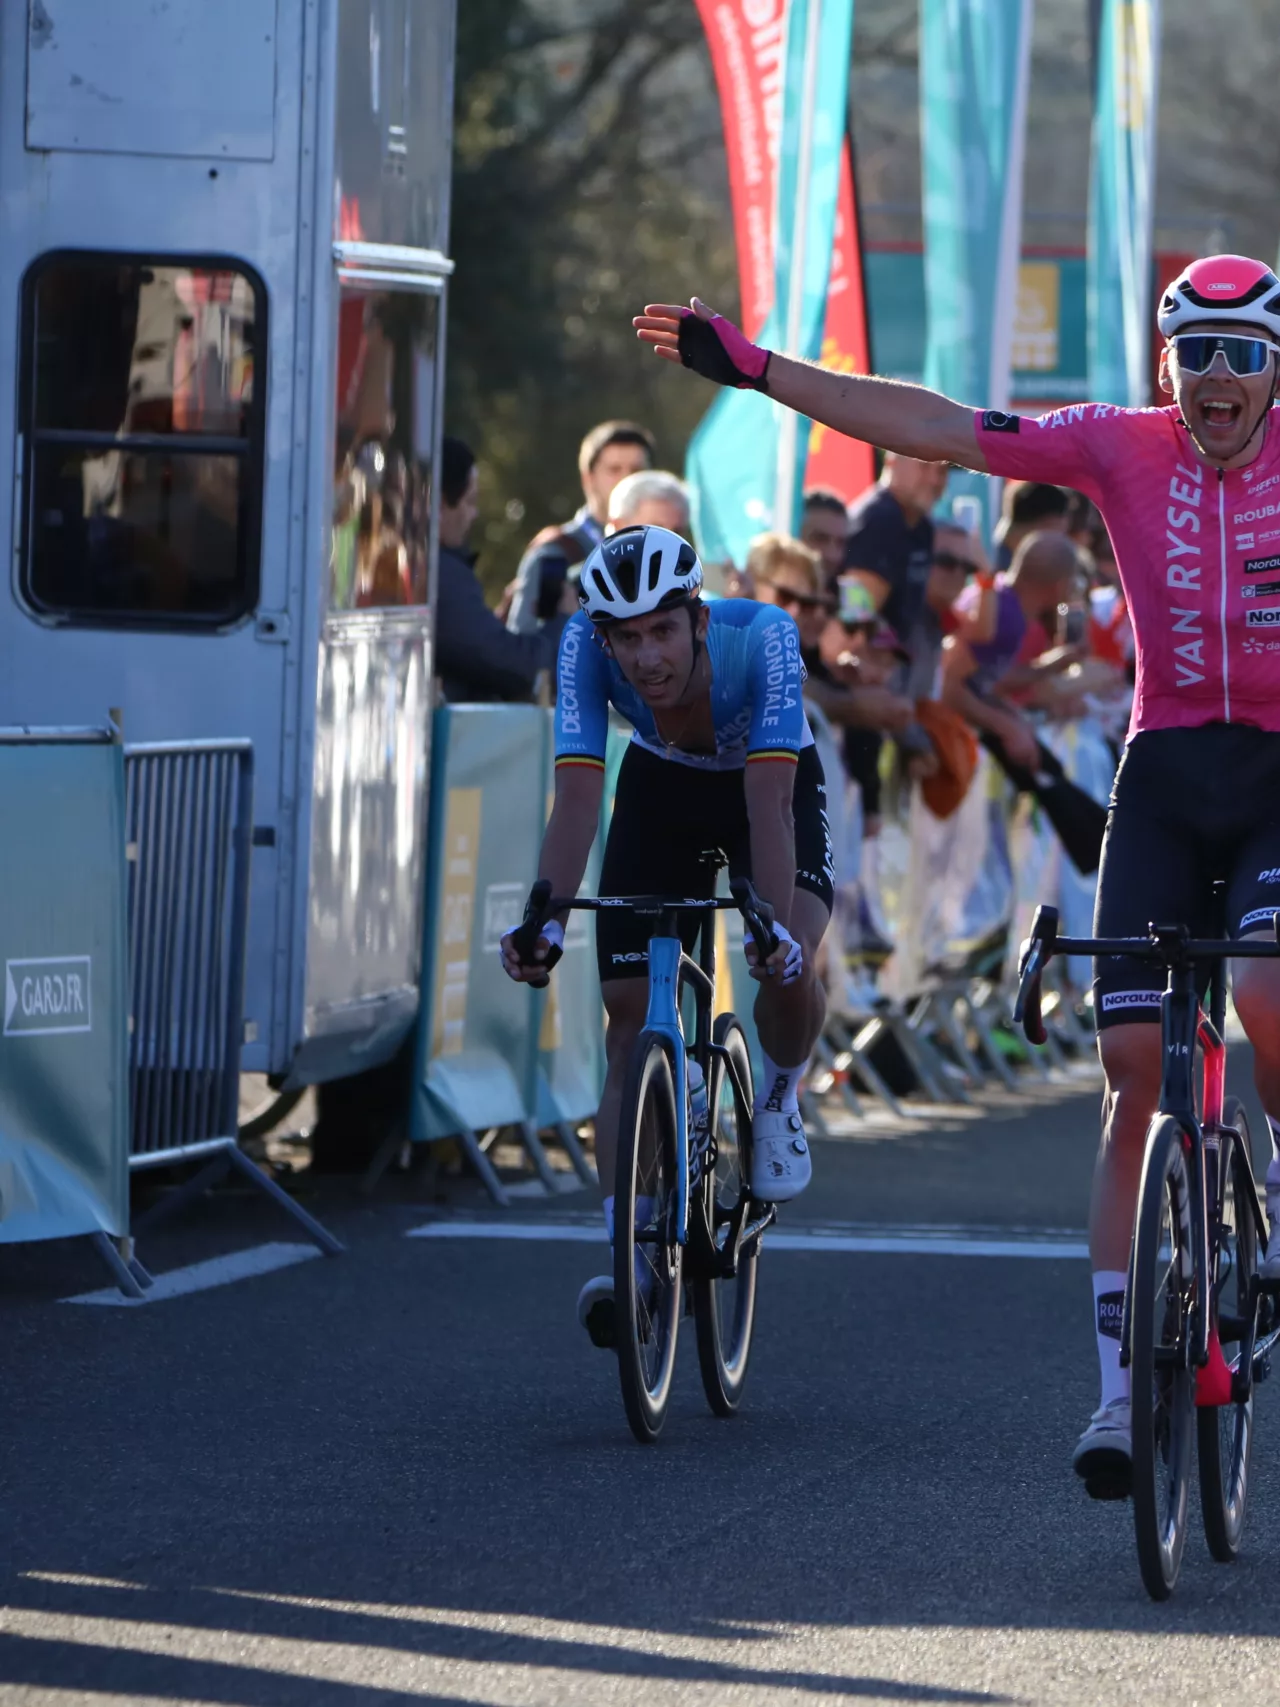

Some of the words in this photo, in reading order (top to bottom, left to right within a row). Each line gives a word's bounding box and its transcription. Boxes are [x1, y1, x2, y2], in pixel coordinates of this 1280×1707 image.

[1166, 463, 1203, 590] RYSEL
[561, 622, 584, 734] DECATHLON
[762, 622, 783, 728] MONDIALE
[780, 621, 798, 676] AG2R
[1169, 607, 1206, 687] VAN
[783, 683, 797, 710] LA
[21, 973, 84, 1016] GARD.FR
